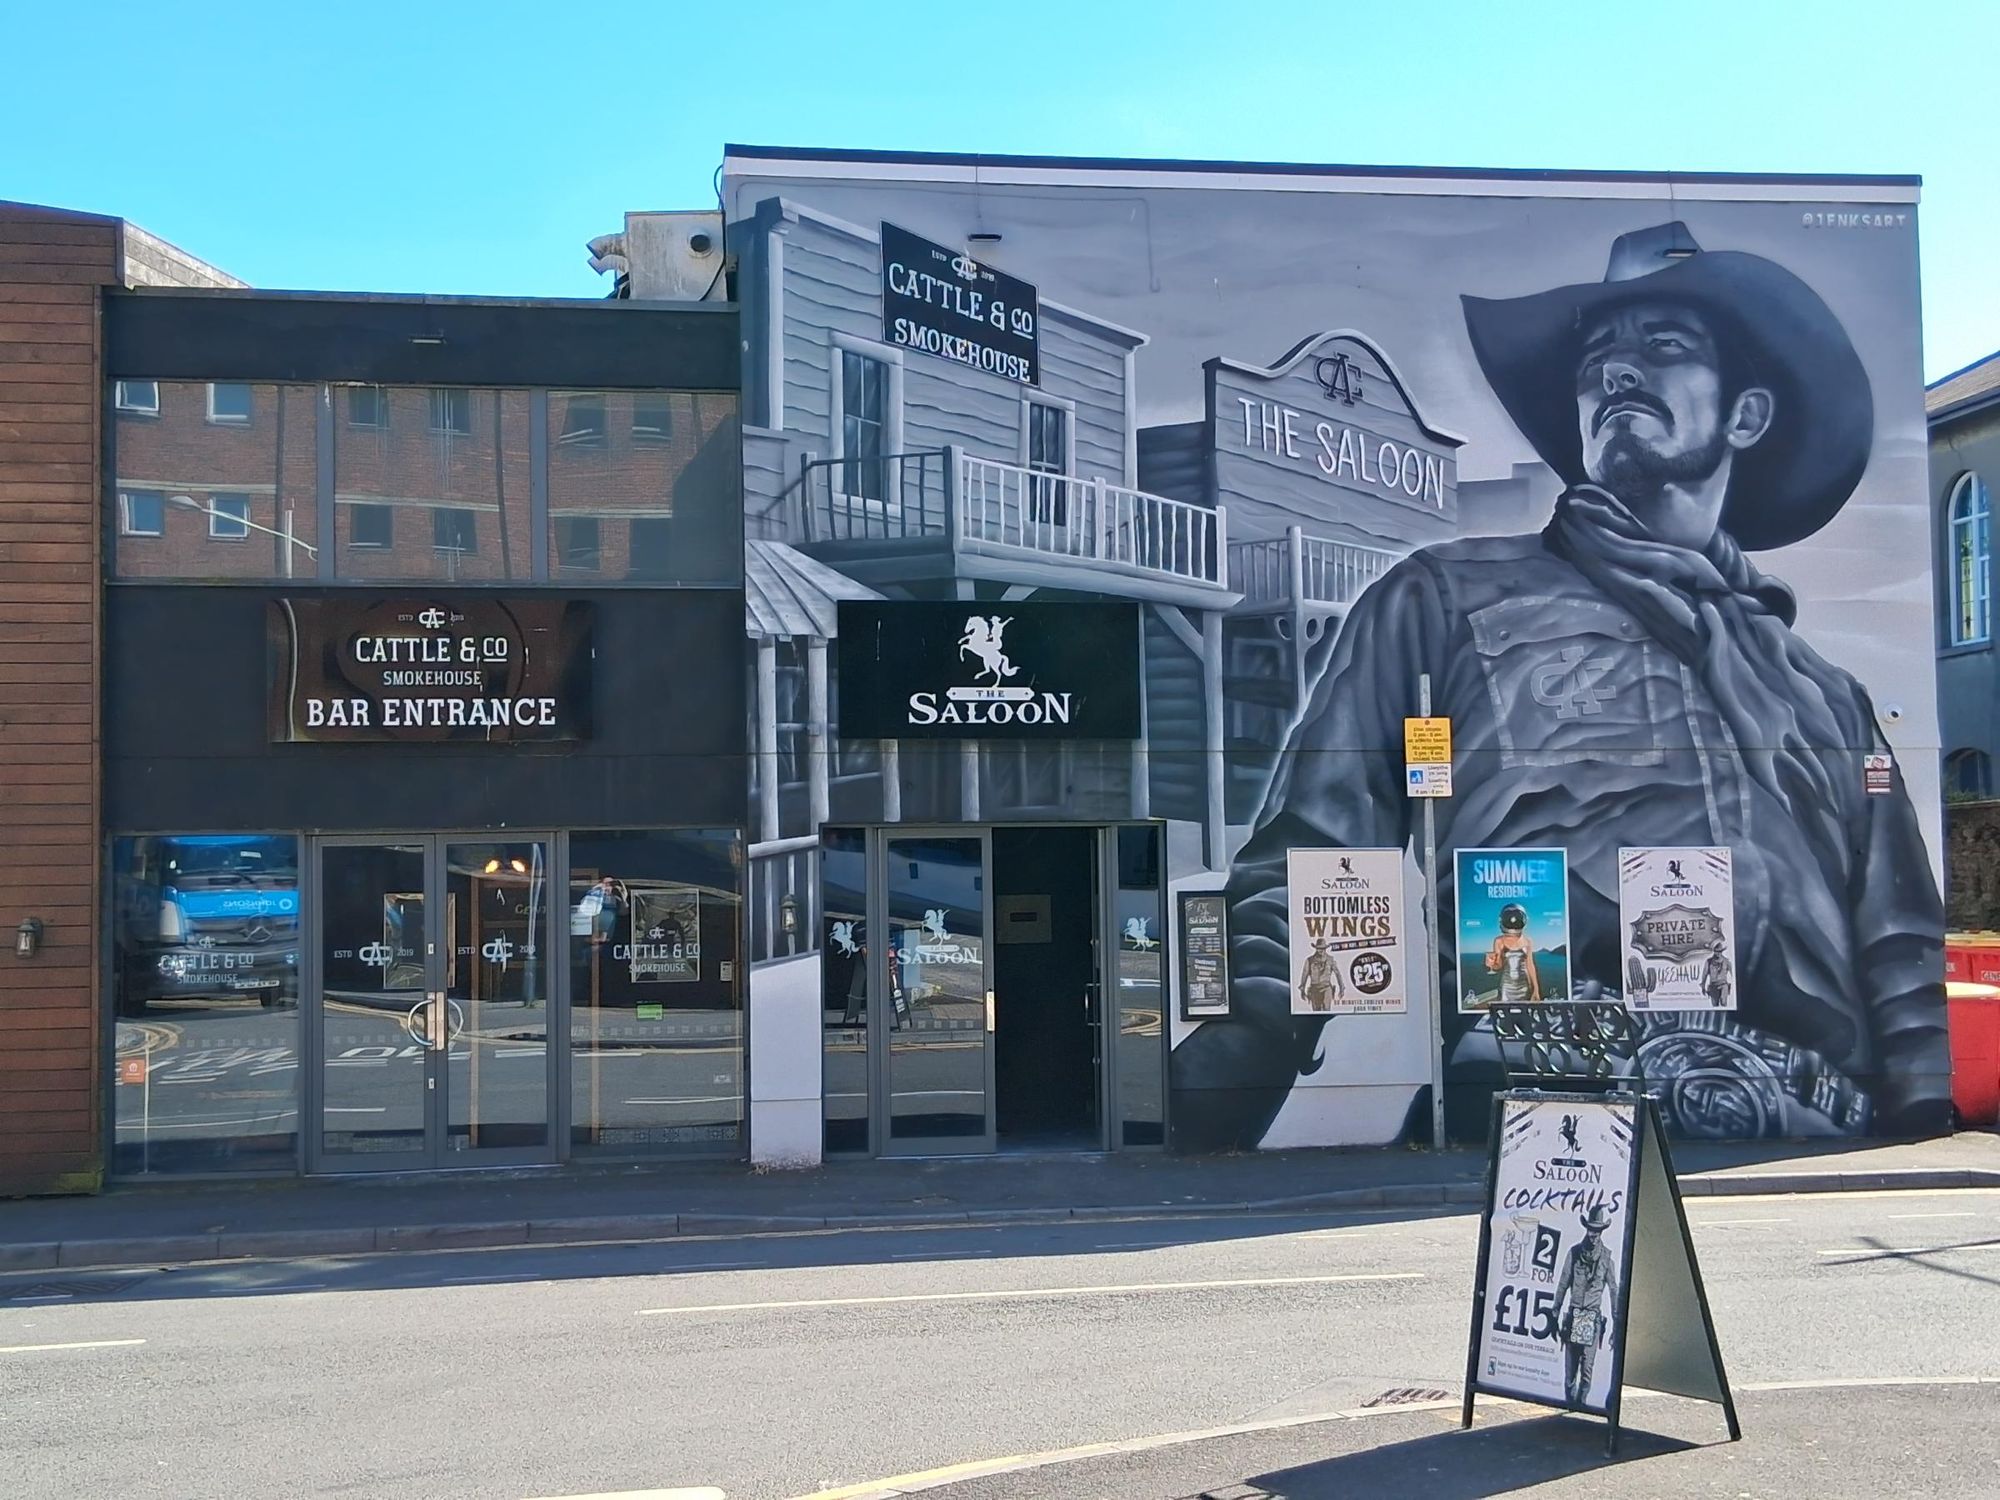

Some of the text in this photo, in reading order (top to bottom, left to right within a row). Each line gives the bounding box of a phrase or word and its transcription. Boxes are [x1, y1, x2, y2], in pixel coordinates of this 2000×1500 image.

[888, 262, 1034, 338] CATTLE & CO
[894, 317, 1031, 383] SMOKEHOUSE
[1237, 396, 1444, 510] THE SALOON
[355, 637, 508, 663] CATTLE & CO
[383, 670, 482, 687] SMOKEHOUSE
[975, 689, 1006, 698] THE
[306, 697, 557, 727] BAR ENTRANCE
[908, 692, 1073, 725] SALOON
[1473, 859, 1547, 885] SUMMER
[1320, 878, 1371, 890] SALOON
[1650, 884, 1704, 898] SALOON
[1303, 895, 1391, 915] BOTTOMLESS
[1304, 915, 1392, 938] WINGS
[1647, 918, 1707, 934] PRIVATE
[1661, 933, 1695, 946] HIRE
[333, 950, 353, 959] ESTD
[397, 949, 414, 958] 2019
[457, 946, 476, 955] ESTD
[613, 943, 701, 960] CATTLE & CO
[896, 946, 979, 965] SALOON
[160, 952, 254, 970] CATTLE & CO
[628, 963, 686, 973] SMOKEHOUSE
[176, 973, 239, 984] SMOKEHOUSE
[1353, 961, 1385, 987] £25
[1533, 1159, 1603, 1184] SALOON
[1503, 1187, 1623, 1214] COCKTAILS
[1536, 1233, 1555, 1265] 2
[1531, 1267, 1555, 1284] FOR
[1492, 1284, 1556, 1340] £15
